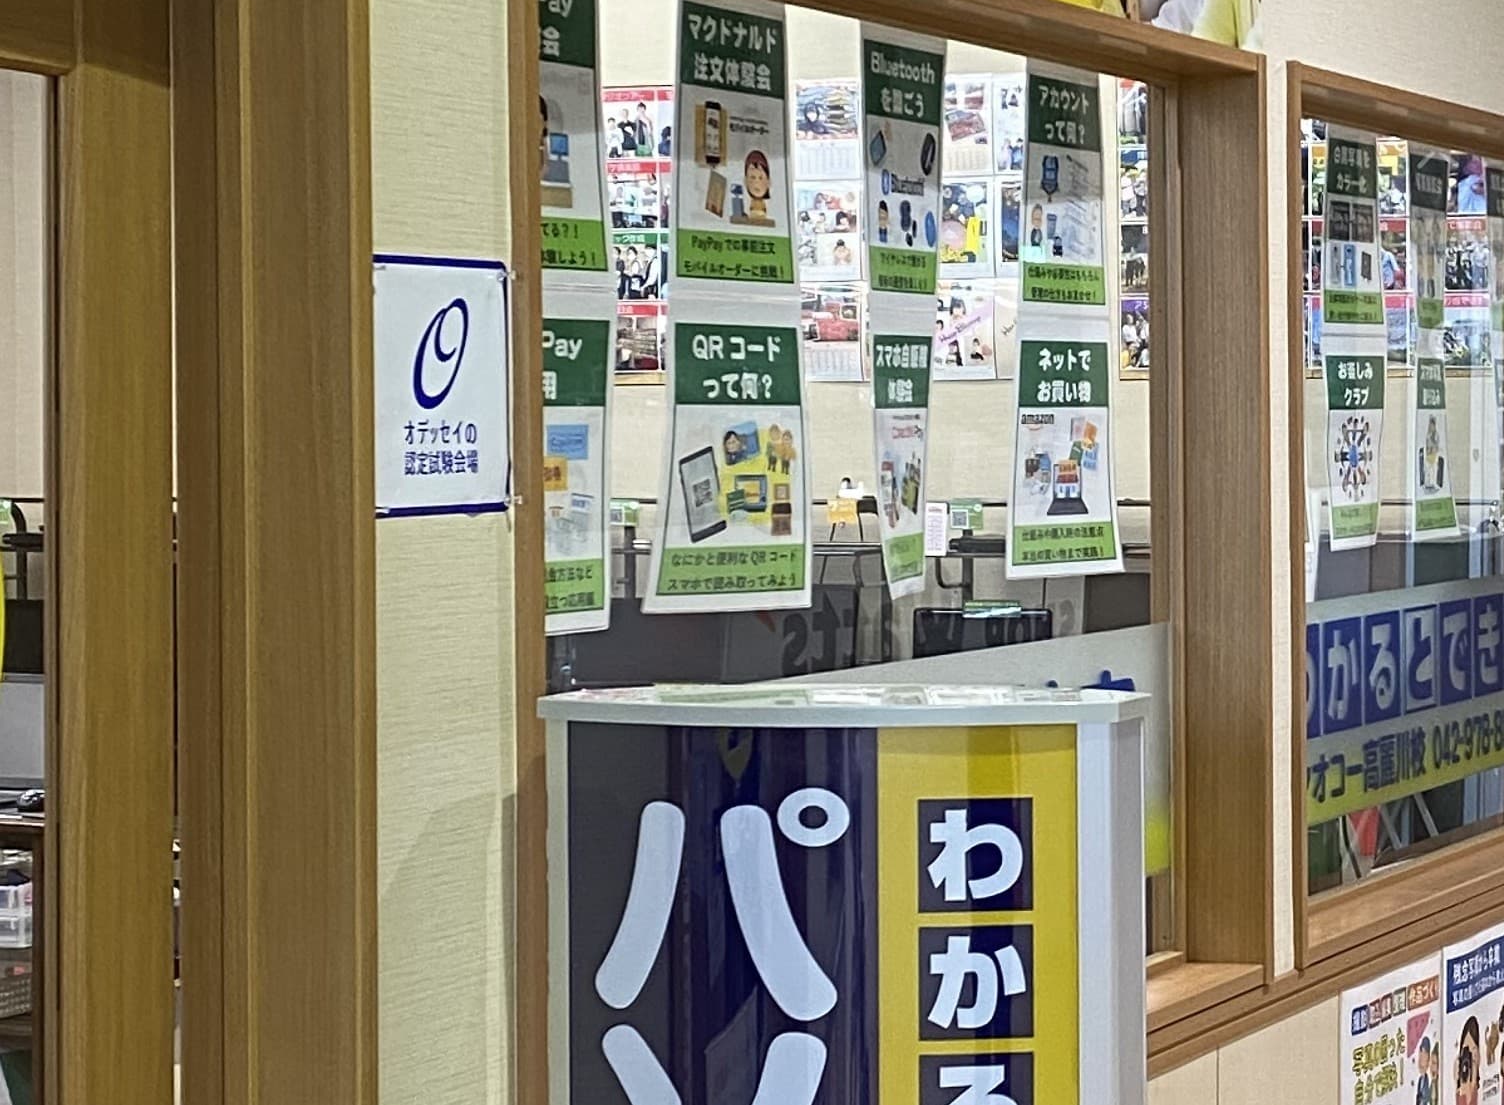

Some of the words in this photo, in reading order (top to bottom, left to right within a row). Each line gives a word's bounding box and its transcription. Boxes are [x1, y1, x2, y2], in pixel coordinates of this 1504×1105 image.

[687, 13, 777, 55] マクドナルド
[693, 52, 772, 92] 注文体験会
[871, 50, 936, 85] Bluetooth
[1037, 84, 1090, 117] アカウント
[1038, 348, 1091, 372] ネットで
[1036, 379, 1092, 404] お買い物
[1343, 386, 1370, 407] クラブ
[404, 419, 478, 445] オデッセイの
[404, 449, 479, 476] 認定試験会場
[1306, 725, 1427, 804] オコー高麗川校
